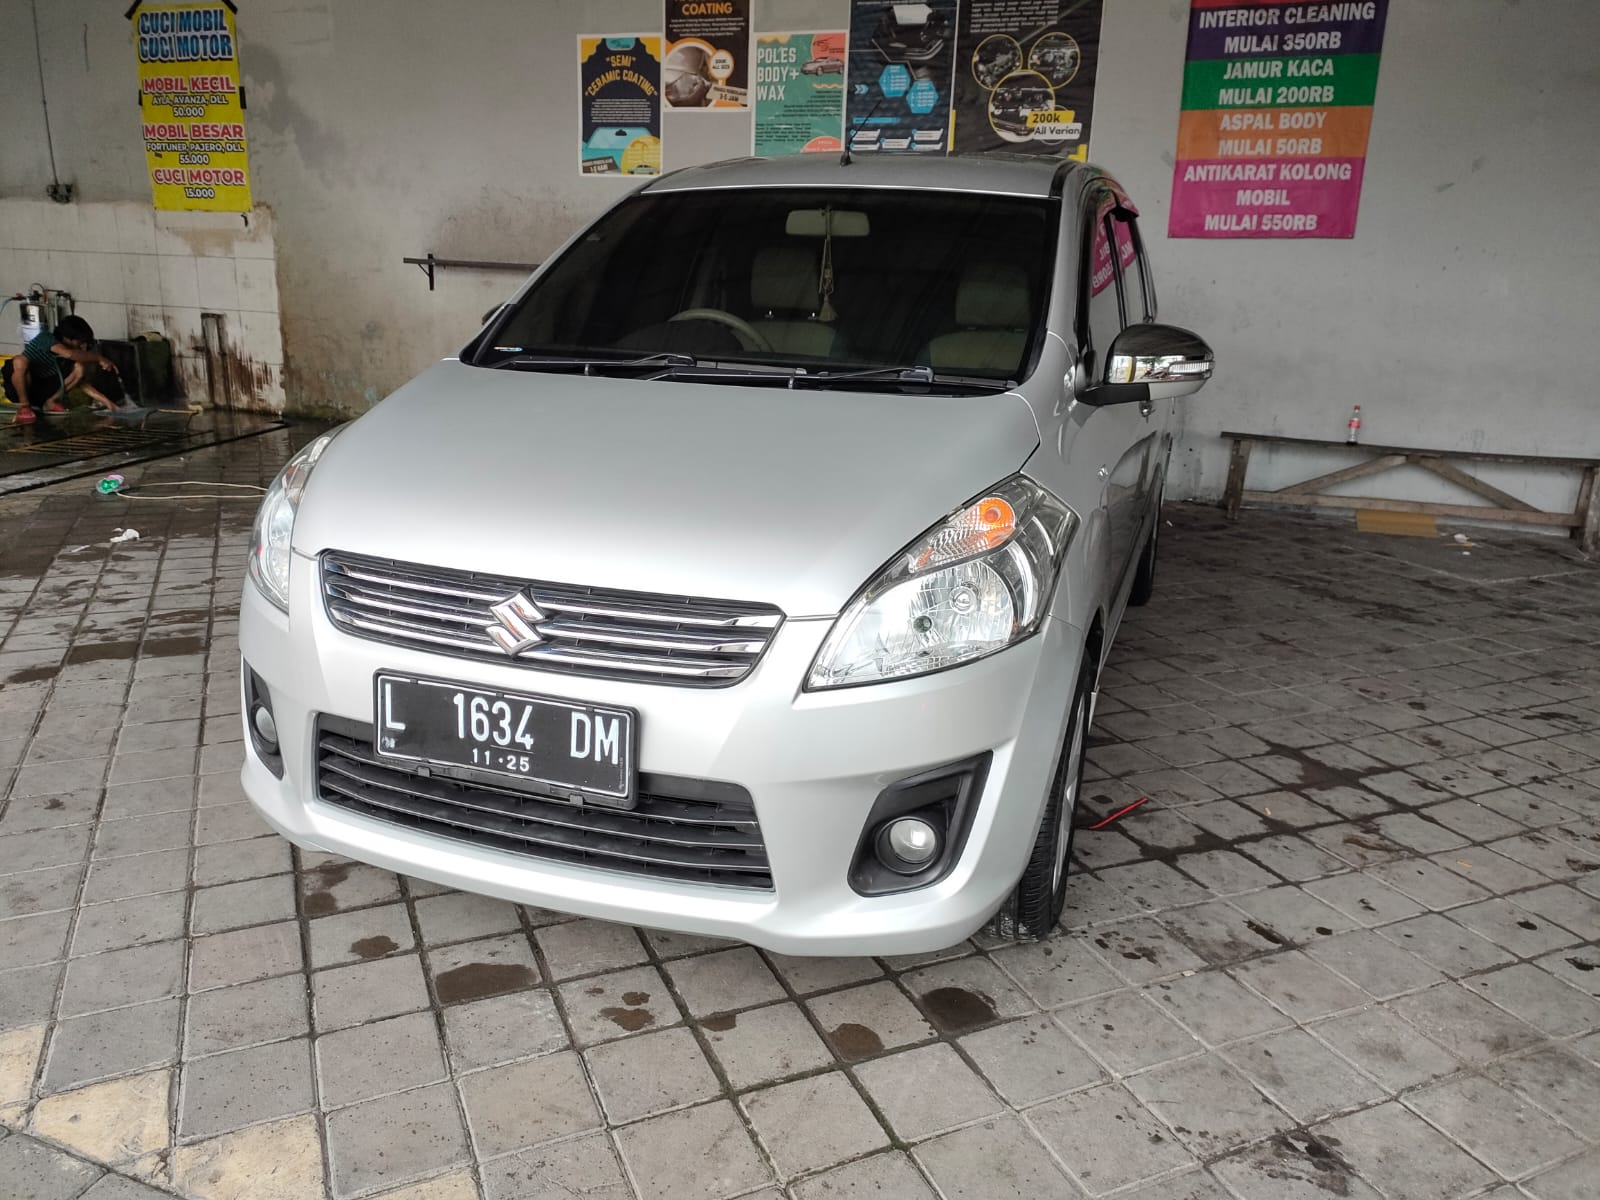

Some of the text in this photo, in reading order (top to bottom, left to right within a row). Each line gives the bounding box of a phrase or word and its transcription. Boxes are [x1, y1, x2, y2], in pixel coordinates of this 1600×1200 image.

[682, 2, 733, 15] COATING
[1199, 2, 1376, 29] INTERIOR CLEANING
[139, 9, 227, 34] CUCI MOBIL
[139, 34, 233, 59] CUCI MOTOR
[1224, 31, 1342, 54] MULAI 350RB
[757, 48, 797, 64] POLES
[1223, 59, 1334, 80] JAMUR KACA
[144, 77, 235, 92] MOBIL KECIL
[173, 96, 209, 105] AVANZA,
[210, 95, 227, 104] DLL
[757, 85, 786, 101] WAX
[1218, 86, 1335, 105] MULAI 200RB
[173, 108, 204, 117] 50.000
[1032, 113, 1061, 123] 200k
[1220, 112, 1327, 130] ASPAL BODY
[144, 124, 244, 138] MOBIL BESAR
[1034, 126, 1080, 135] All Varian
[190, 143, 225, 153] PAJERO,
[226, 143, 243, 152] DLL
[1218, 138, 1322, 156] MULAI 50RB
[179, 155, 209, 164] 55.000
[154, 169, 244, 183] CUCI MOTOR
[1184, 163, 1352, 182] ANTIKARAT KOLONG
[185, 188, 215, 198] 15.000
[1236, 190, 1291, 206] MOBIL
[1204, 214, 1318, 231] MULAI 550RB
[385, 683, 620, 765] L 1634 DM
